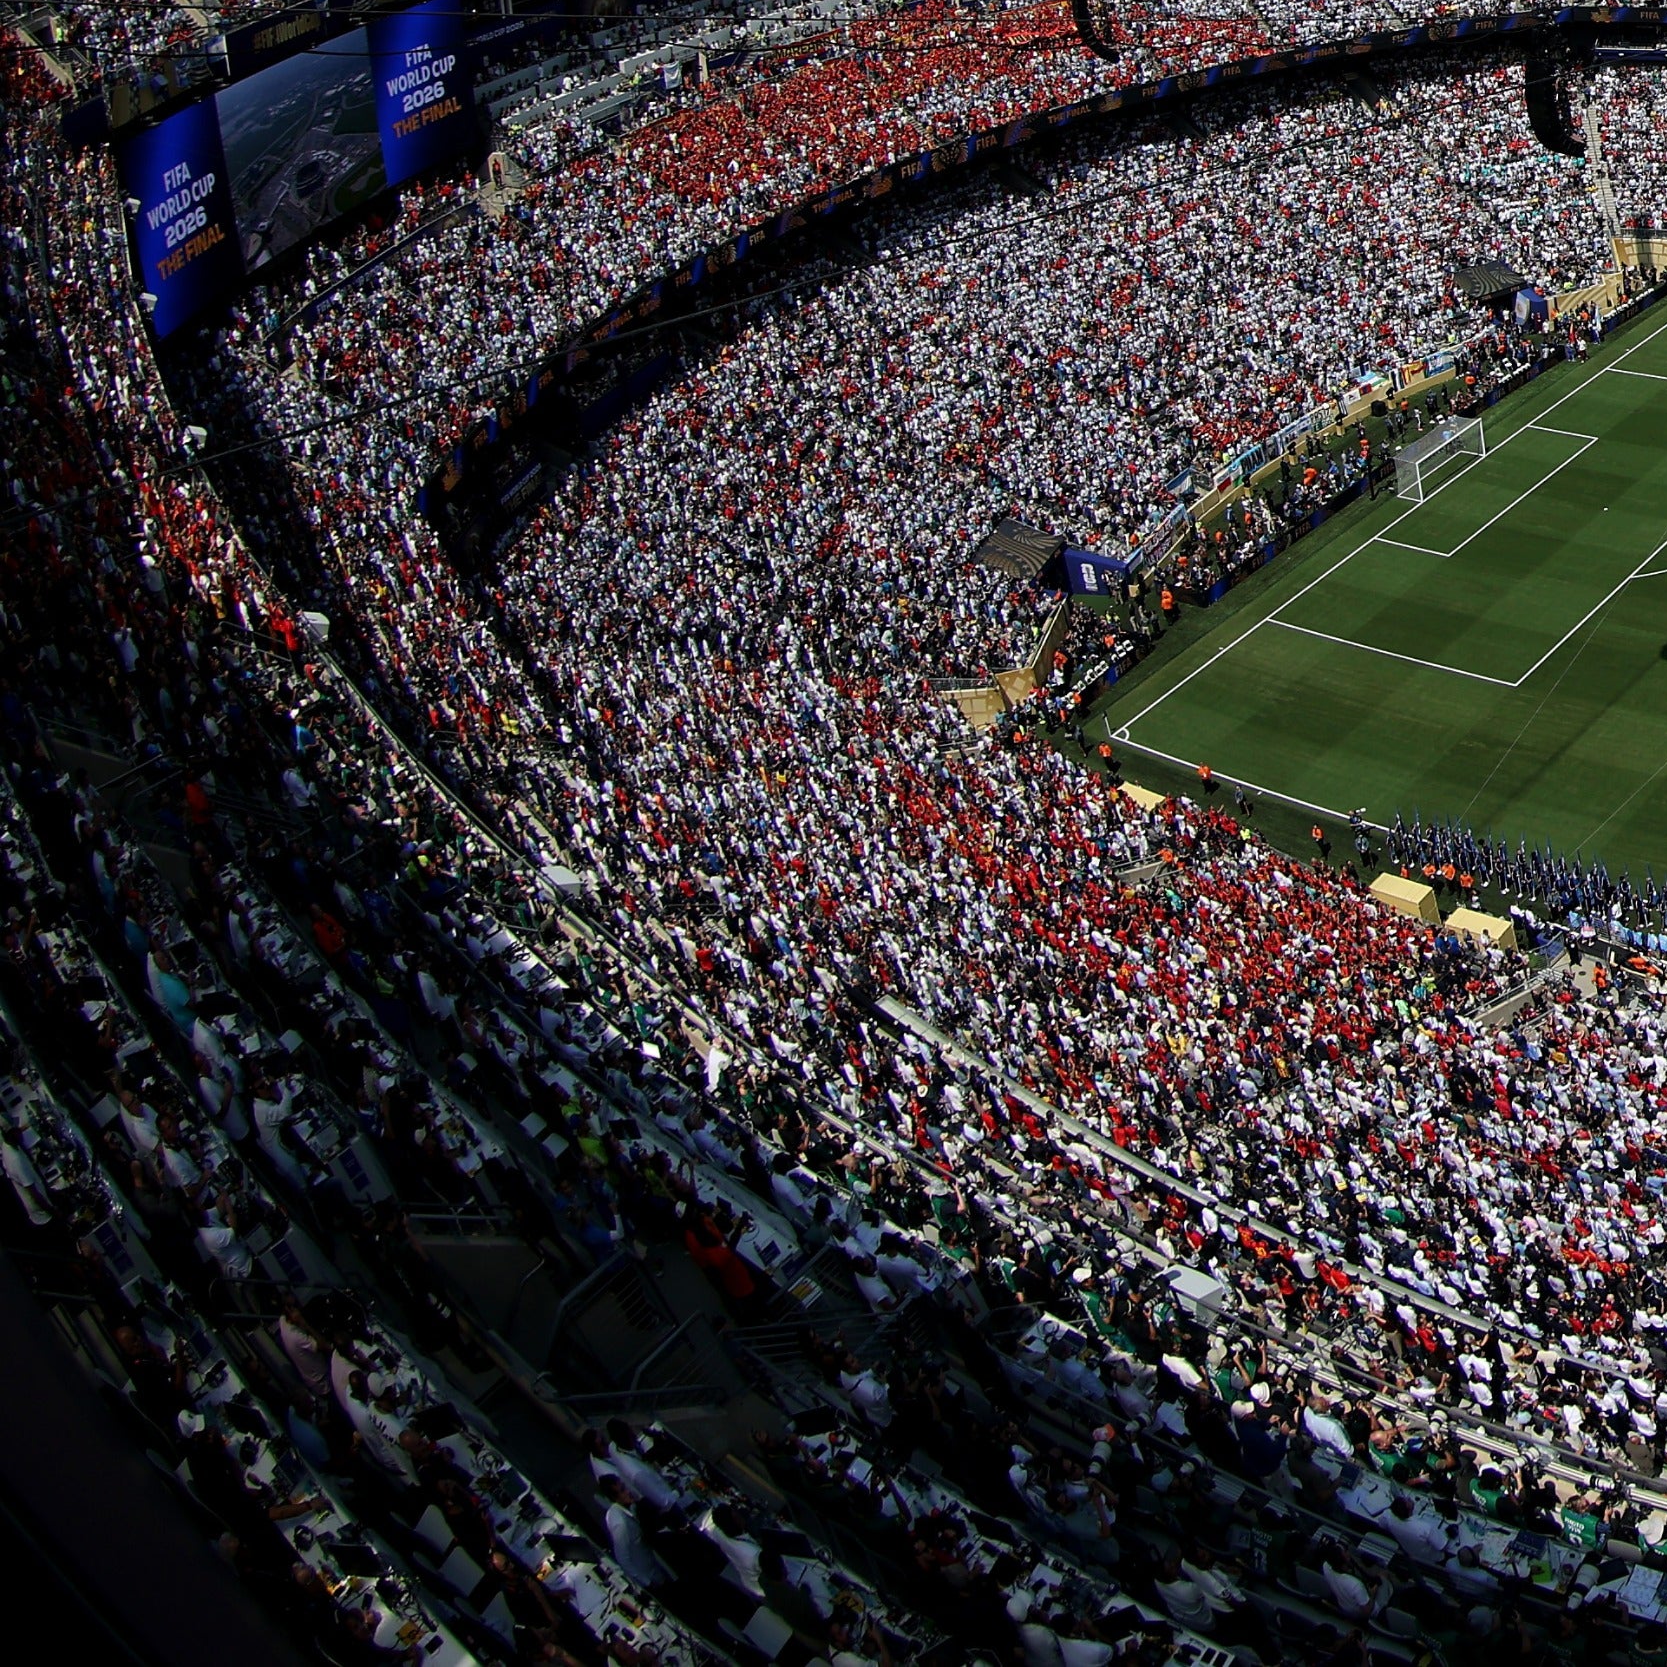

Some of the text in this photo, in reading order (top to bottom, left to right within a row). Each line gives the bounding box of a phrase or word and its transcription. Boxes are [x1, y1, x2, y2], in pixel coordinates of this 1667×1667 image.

[1475, 20, 1493, 30] FIFA
[1640, 11, 1659, 20] FIFA
[404, 43, 432, 68] FIFA
[385, 54, 457, 97] WORLD CUP
[1223, 67, 1241, 77] FIFA
[401, 81, 446, 113] 2026
[391, 96, 463, 138] THE FINAL
[975, 135, 998, 151] FIFA
[163, 162, 191, 193] FIFA
[146, 172, 216, 231] WORLD CUP
[164, 206, 208, 249] 2026
[156, 222, 226, 281] THE FINAL
